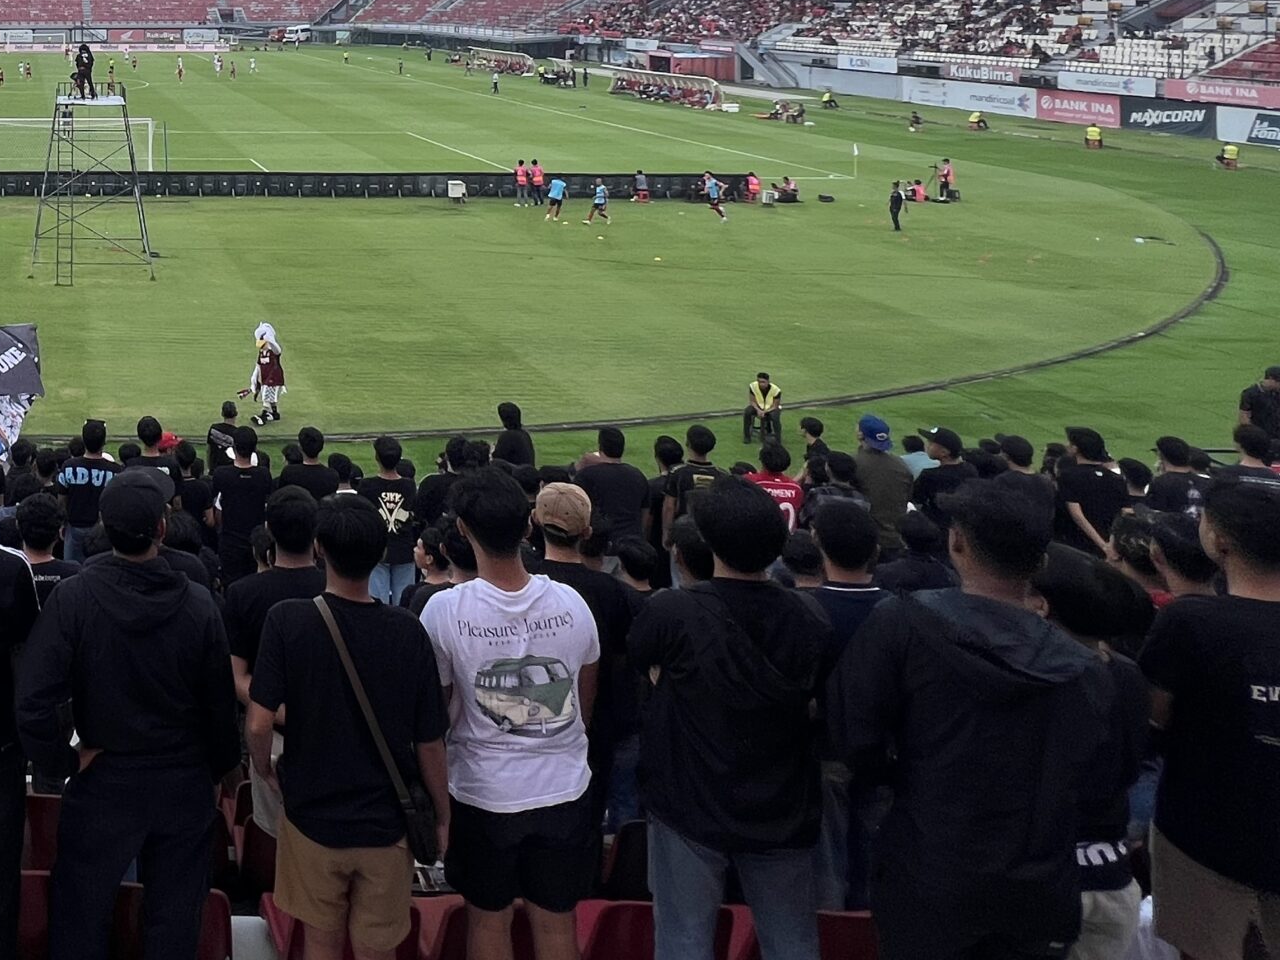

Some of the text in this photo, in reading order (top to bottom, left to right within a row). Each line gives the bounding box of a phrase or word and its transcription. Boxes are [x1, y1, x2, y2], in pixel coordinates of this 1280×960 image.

[950, 64, 1014, 81] KukuBima
[1200, 84, 1259, 98] BANK INA
[1054, 99, 1114, 115] BANK INA
[1129, 108, 1207, 128] MAXICORN
[457, 619, 519, 639] Pleasure
[523, 610, 575, 635] Journey
